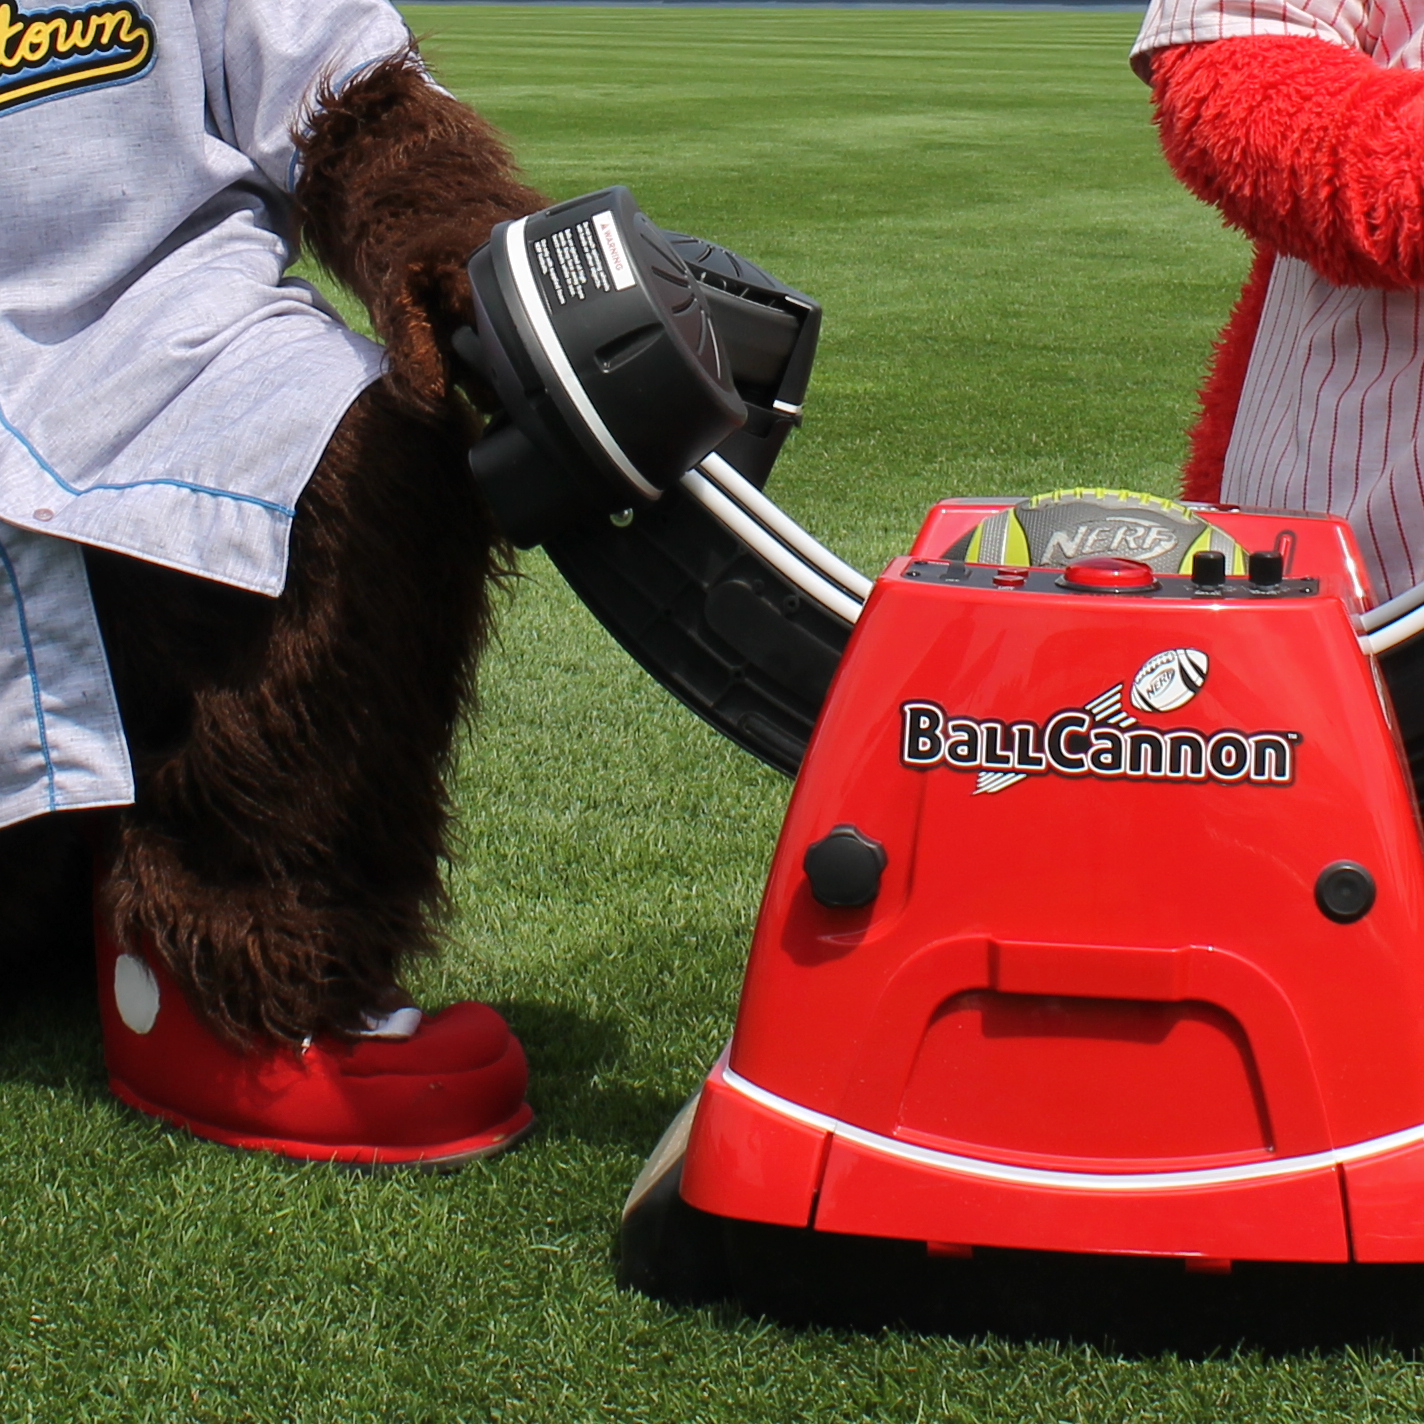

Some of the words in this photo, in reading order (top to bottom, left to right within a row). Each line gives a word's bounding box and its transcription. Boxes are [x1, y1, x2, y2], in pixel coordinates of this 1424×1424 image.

[603, 228, 623, 272] WARNING
[1040, 522, 1178, 566] NERF
[1145, 669, 1175, 700] NERF
